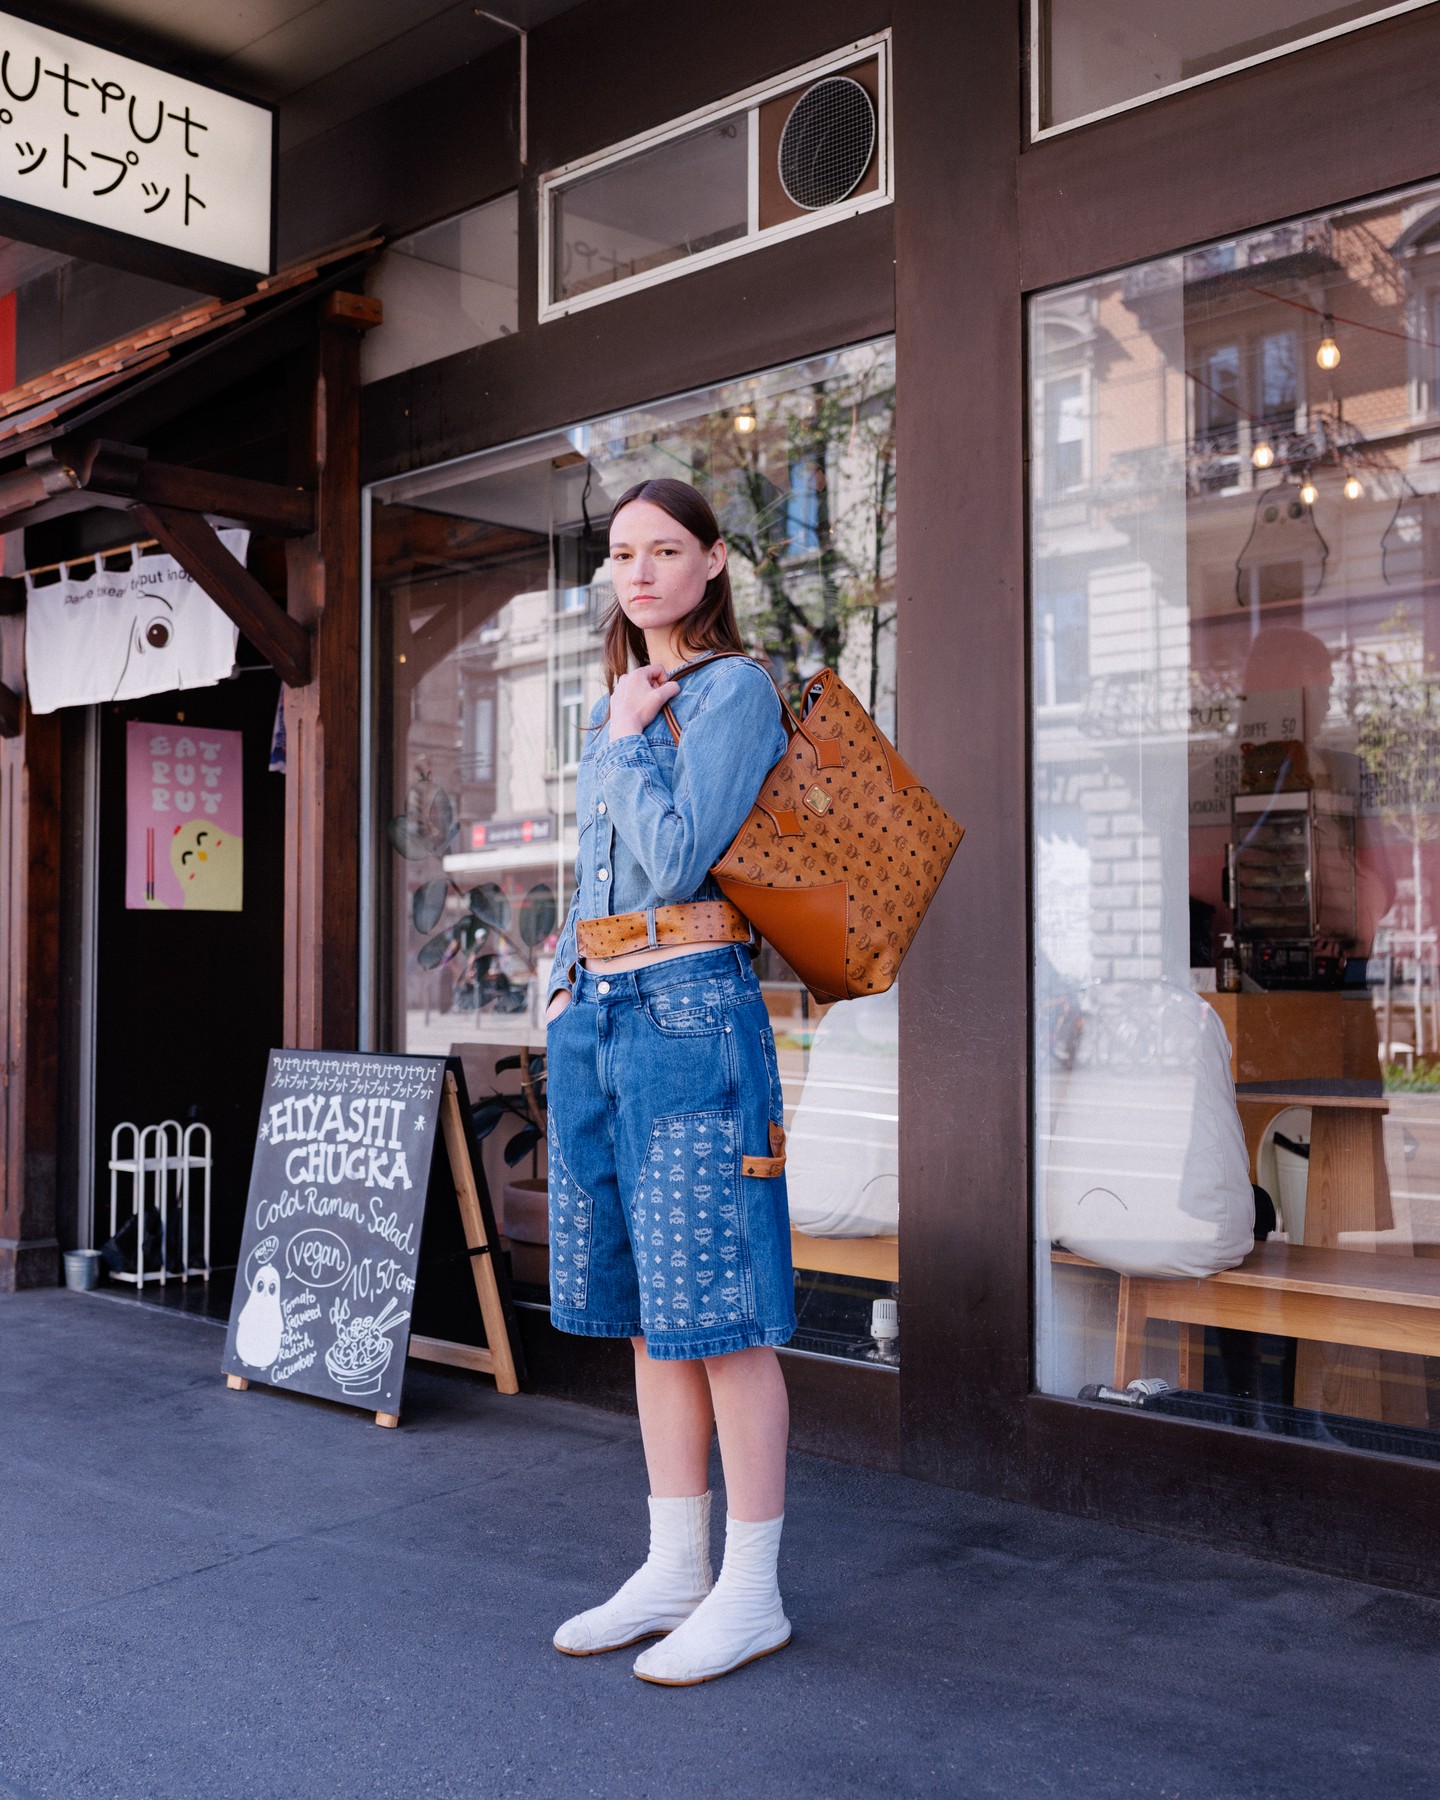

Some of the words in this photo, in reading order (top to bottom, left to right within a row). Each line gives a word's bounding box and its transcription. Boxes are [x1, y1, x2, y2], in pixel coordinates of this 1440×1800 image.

[0, 108, 206, 226] ットプット
[150, 736, 222, 761] EAT
[152, 761, 222, 787] PUT
[152, 788, 222, 815] PUT
[268, 1093, 406, 1149] HIYASHI
[255, 1190, 305, 1231] Cold
[304, 1187, 365, 1224] Ramen
[367, 1197, 415, 1255] Salad
[281, 1288, 317, 1317] Tomato
[278, 1332, 315, 1363] Radish
[281, 1329, 303, 1347] Tofu
[271, 1350, 318, 1384] Cucumber
